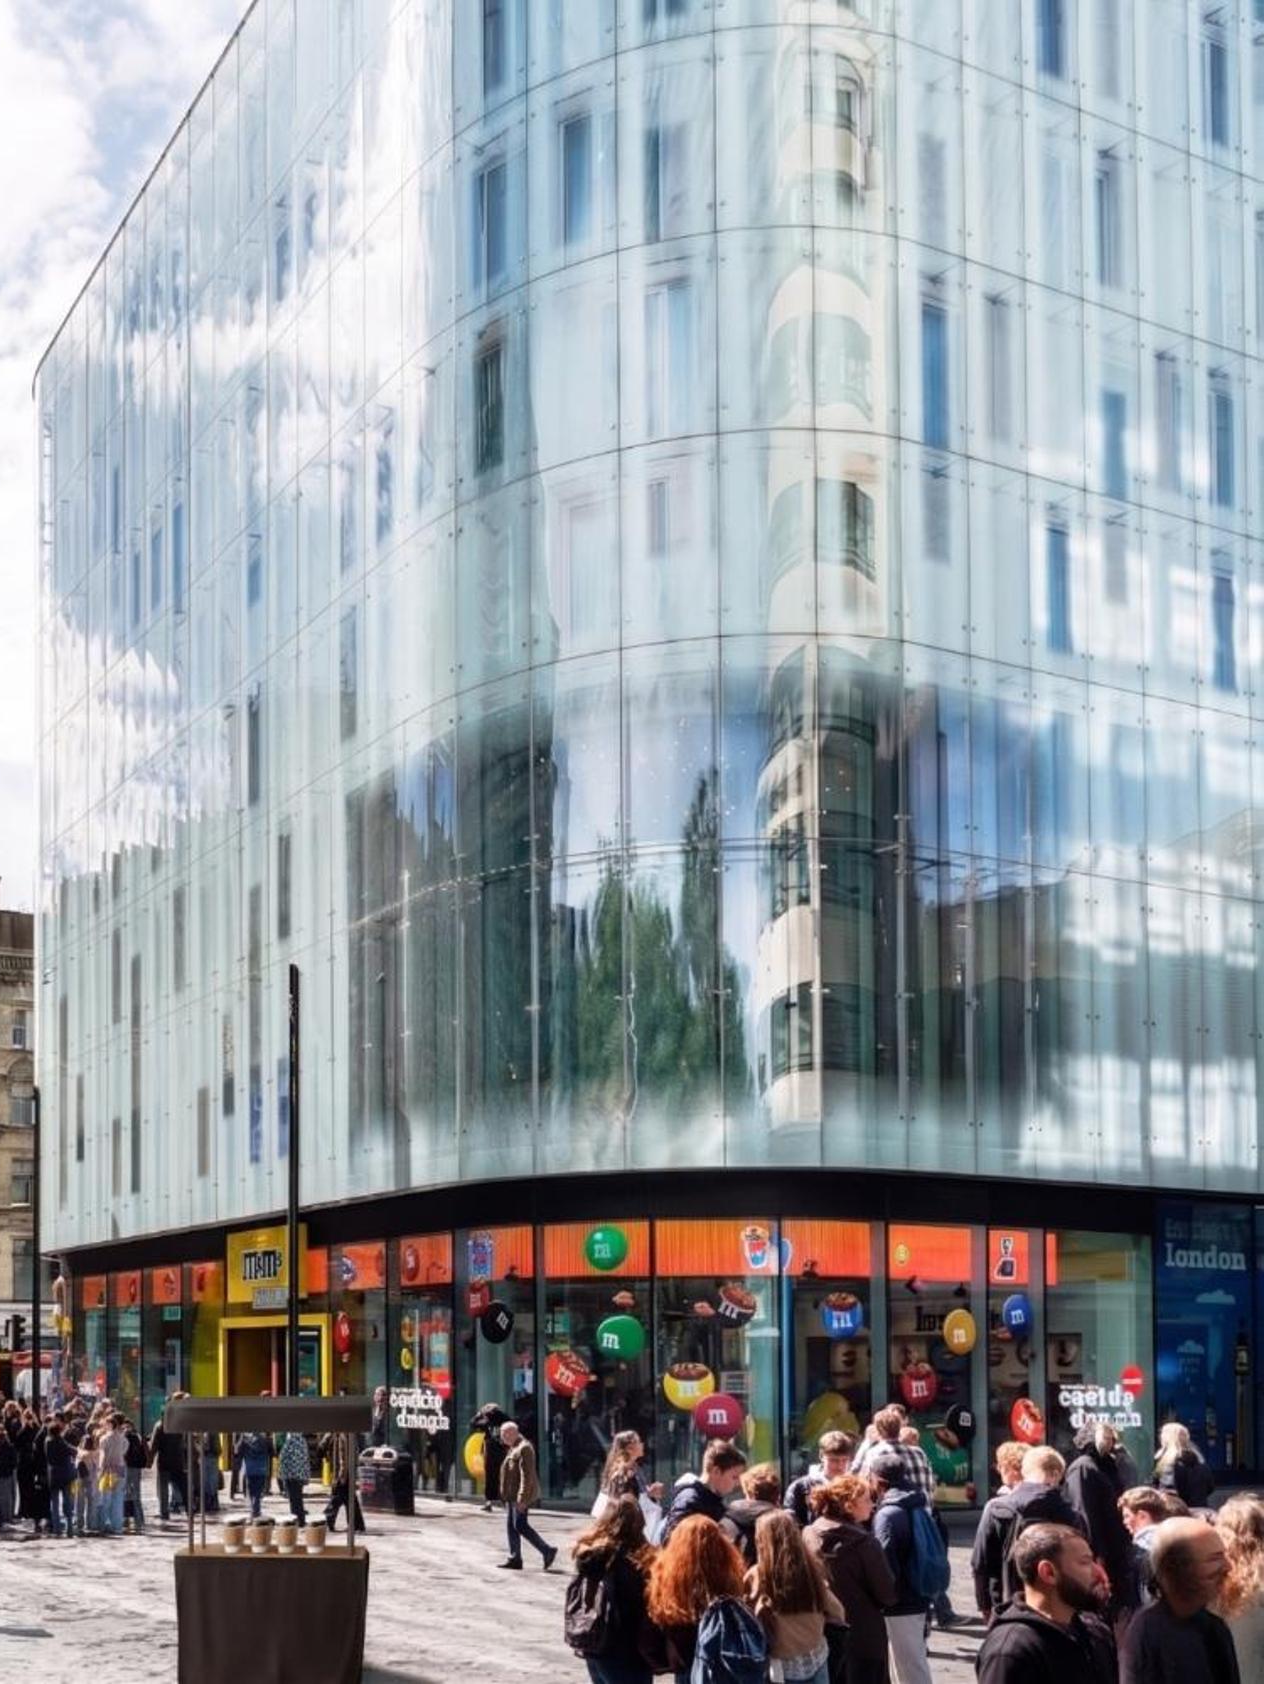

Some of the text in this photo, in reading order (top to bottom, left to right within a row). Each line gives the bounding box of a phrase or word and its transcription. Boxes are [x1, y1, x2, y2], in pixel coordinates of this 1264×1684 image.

[1010, 1308, 1025, 1325] m
[602, 1332, 620, 1350] m
[952, 1329, 967, 1345] m
[910, 1380, 929, 1398] m
[707, 1408, 729, 1425] m
